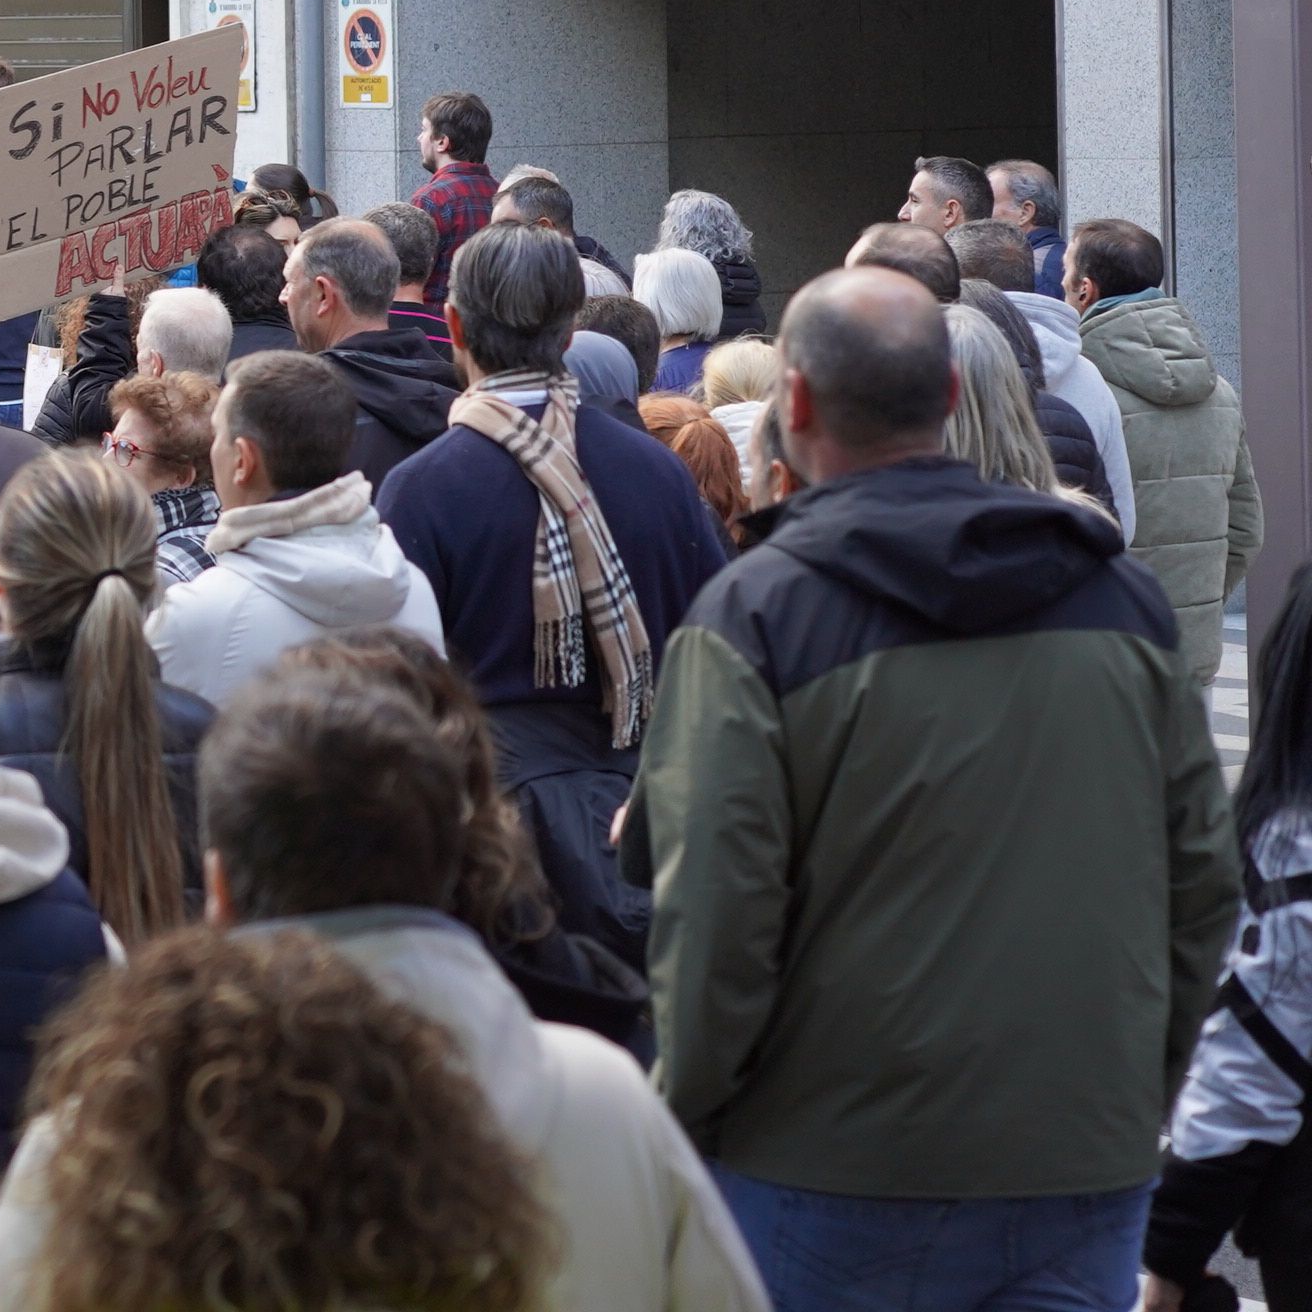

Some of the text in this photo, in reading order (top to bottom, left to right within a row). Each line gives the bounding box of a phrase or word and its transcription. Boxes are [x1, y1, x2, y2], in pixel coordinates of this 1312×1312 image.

[8, 55, 211, 160] Si No Voleu
[44, 95, 230, 187] PARLAR
[6, 165, 162, 251] EL POBLE
[54, 164, 234, 297] ACTUARÀ
